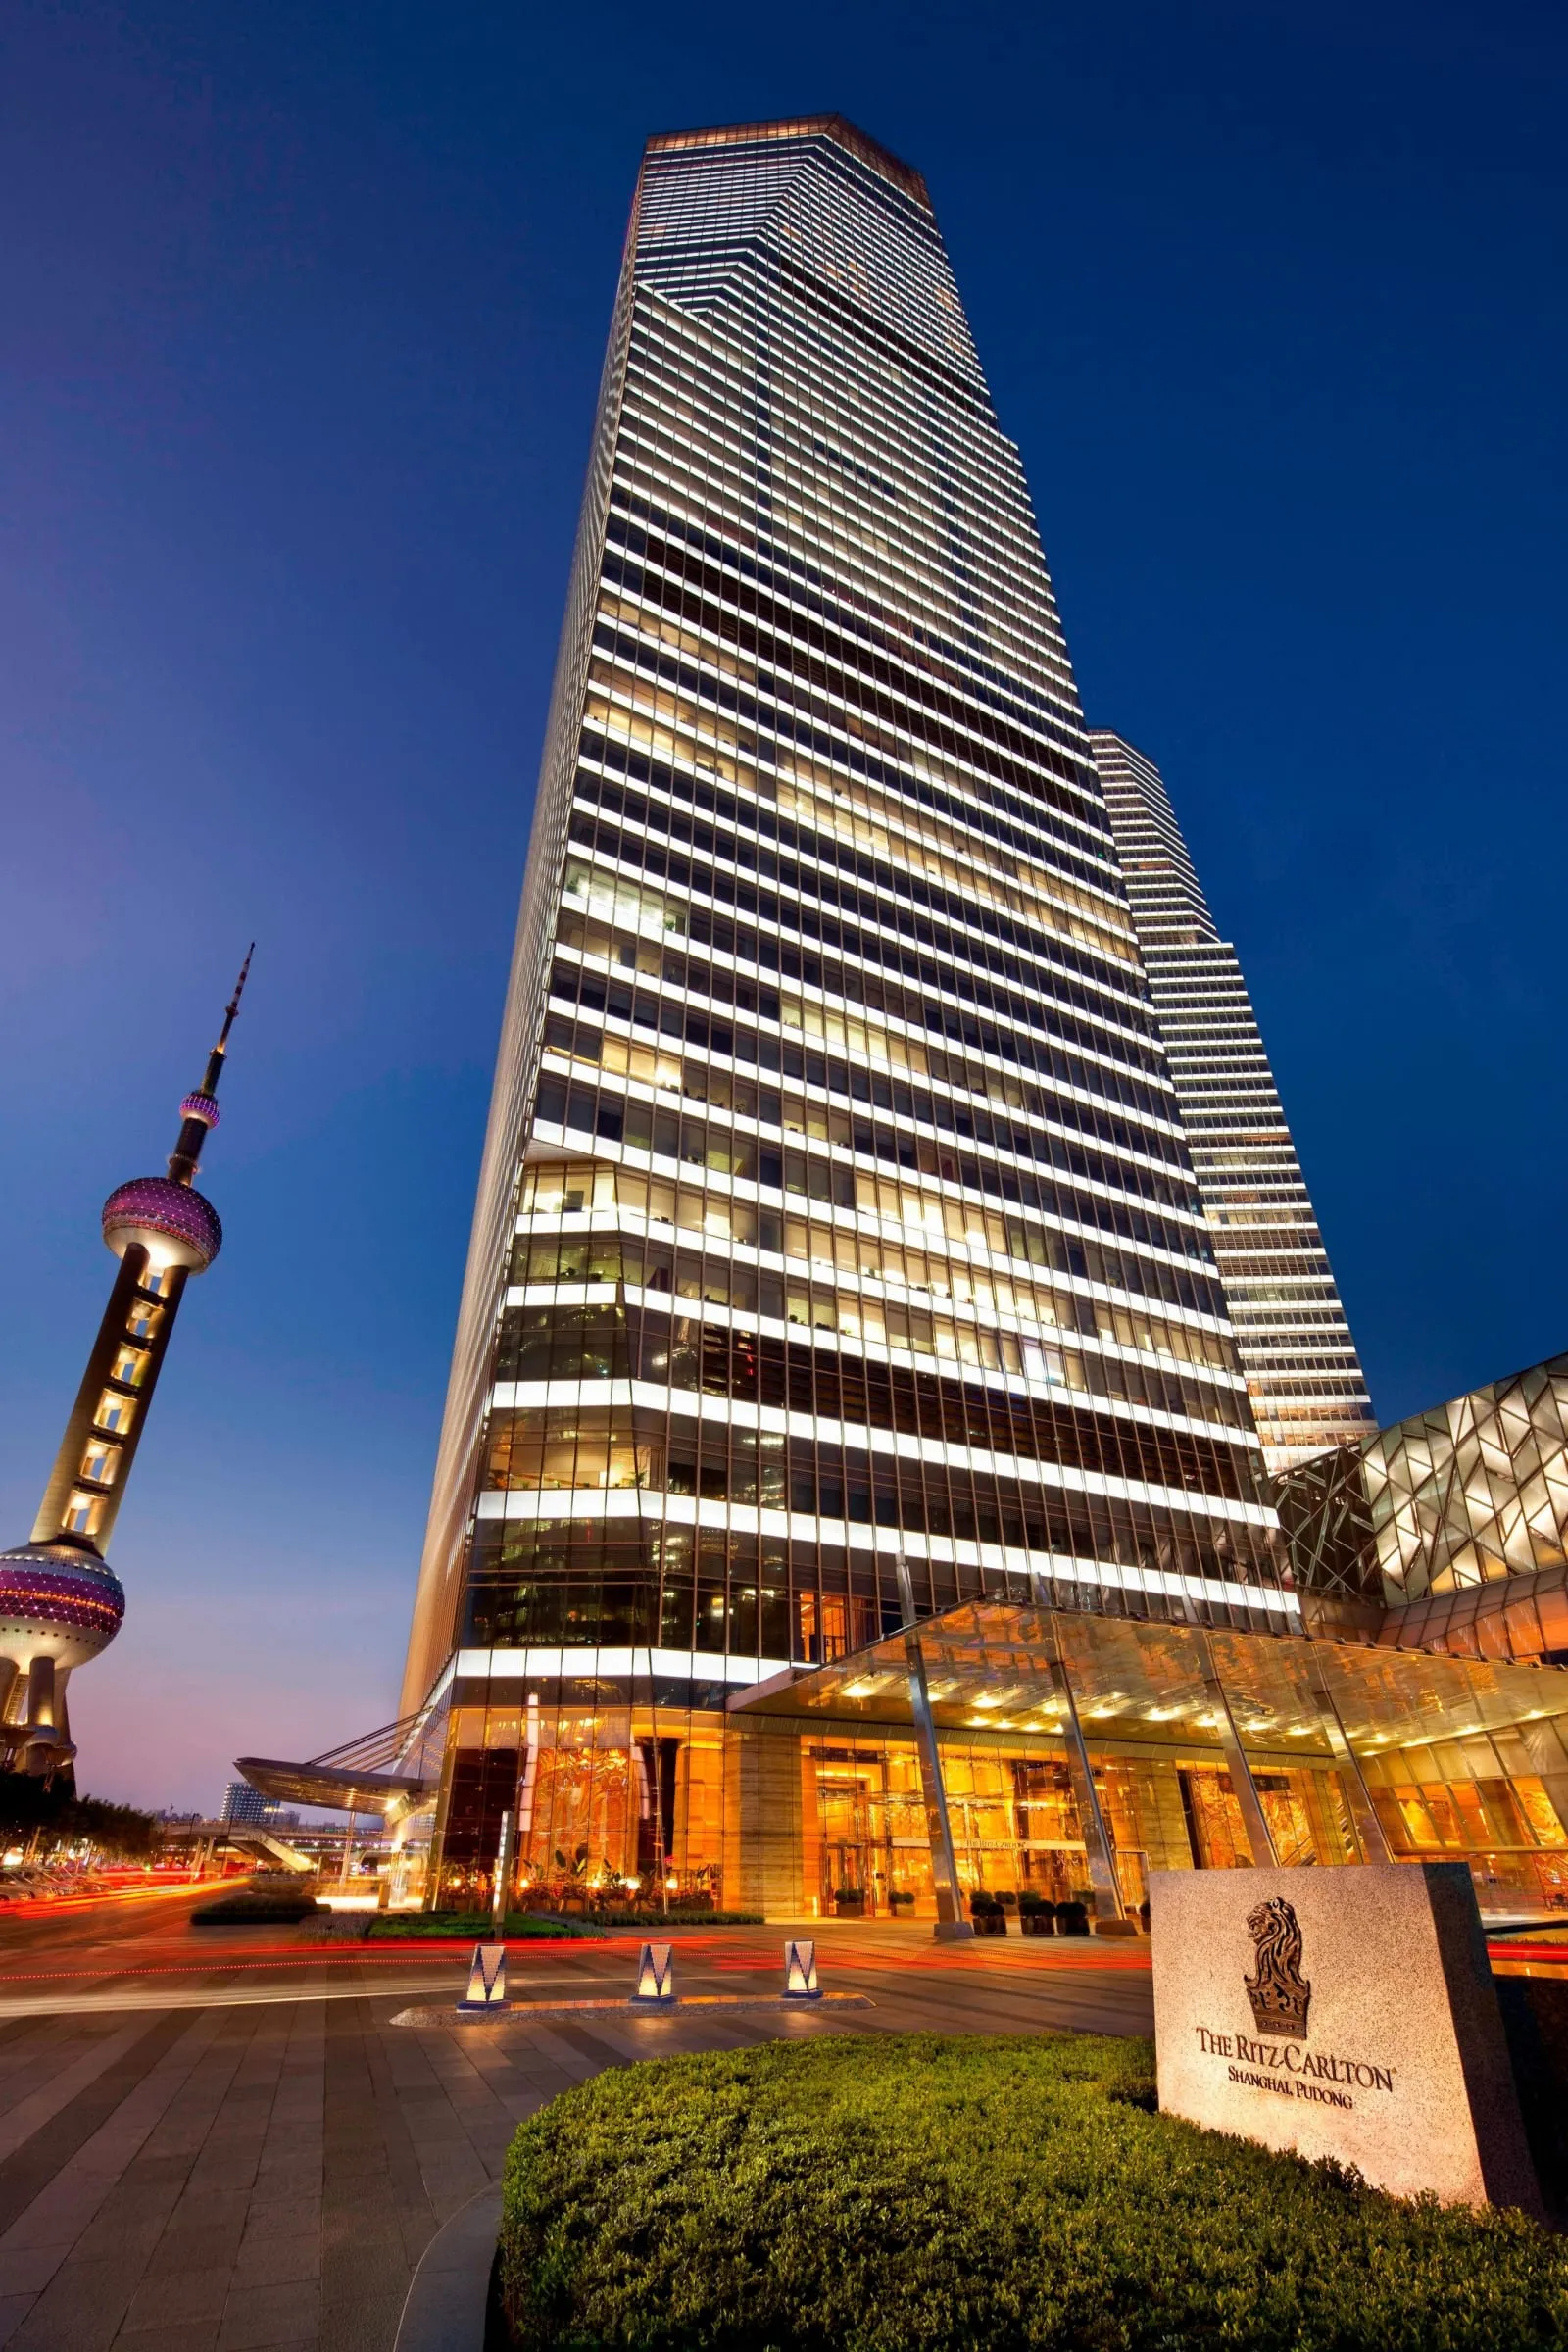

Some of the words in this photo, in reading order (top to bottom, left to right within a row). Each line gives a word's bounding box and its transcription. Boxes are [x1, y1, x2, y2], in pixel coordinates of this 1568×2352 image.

[1196, 2026, 1233, 2058] THE
[1228, 2065, 1293, 2096] SHANGHAI,
[1295, 2081, 1352, 2109] PUDONG
